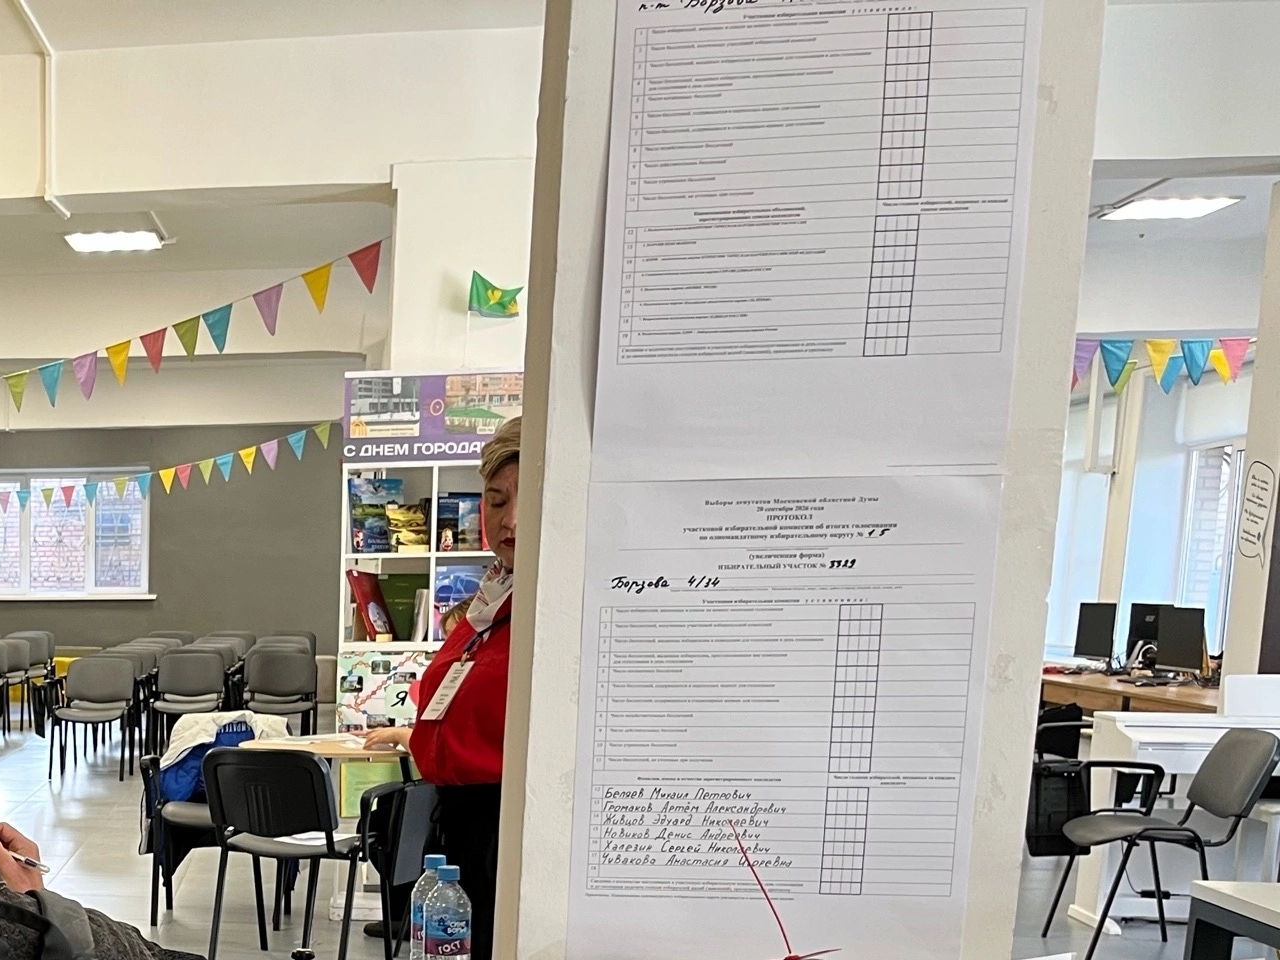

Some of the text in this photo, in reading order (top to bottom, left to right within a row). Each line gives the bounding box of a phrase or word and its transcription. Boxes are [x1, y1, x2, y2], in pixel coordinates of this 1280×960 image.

[343, 445, 357, 457] С
[358, 443, 409, 457] ДНЕМ
[766, 513, 813, 521] ПРОТОКОЛ
[611, 576, 670, 594] Борзова
[390, 690, 408, 708] Я
[604, 787, 645, 799] Беляев
[650, 787, 690, 800] Михаил
[694, 787, 752, 800] Петрович
[602, 800, 653, 813] Громаков
[705, 800, 787, 816] Александрович
[603, 827, 650, 839] Новиков
[655, 827, 693, 841] Денис
[660, 839, 701, 853] Сергей
[665, 853, 729, 867] Анастасия
